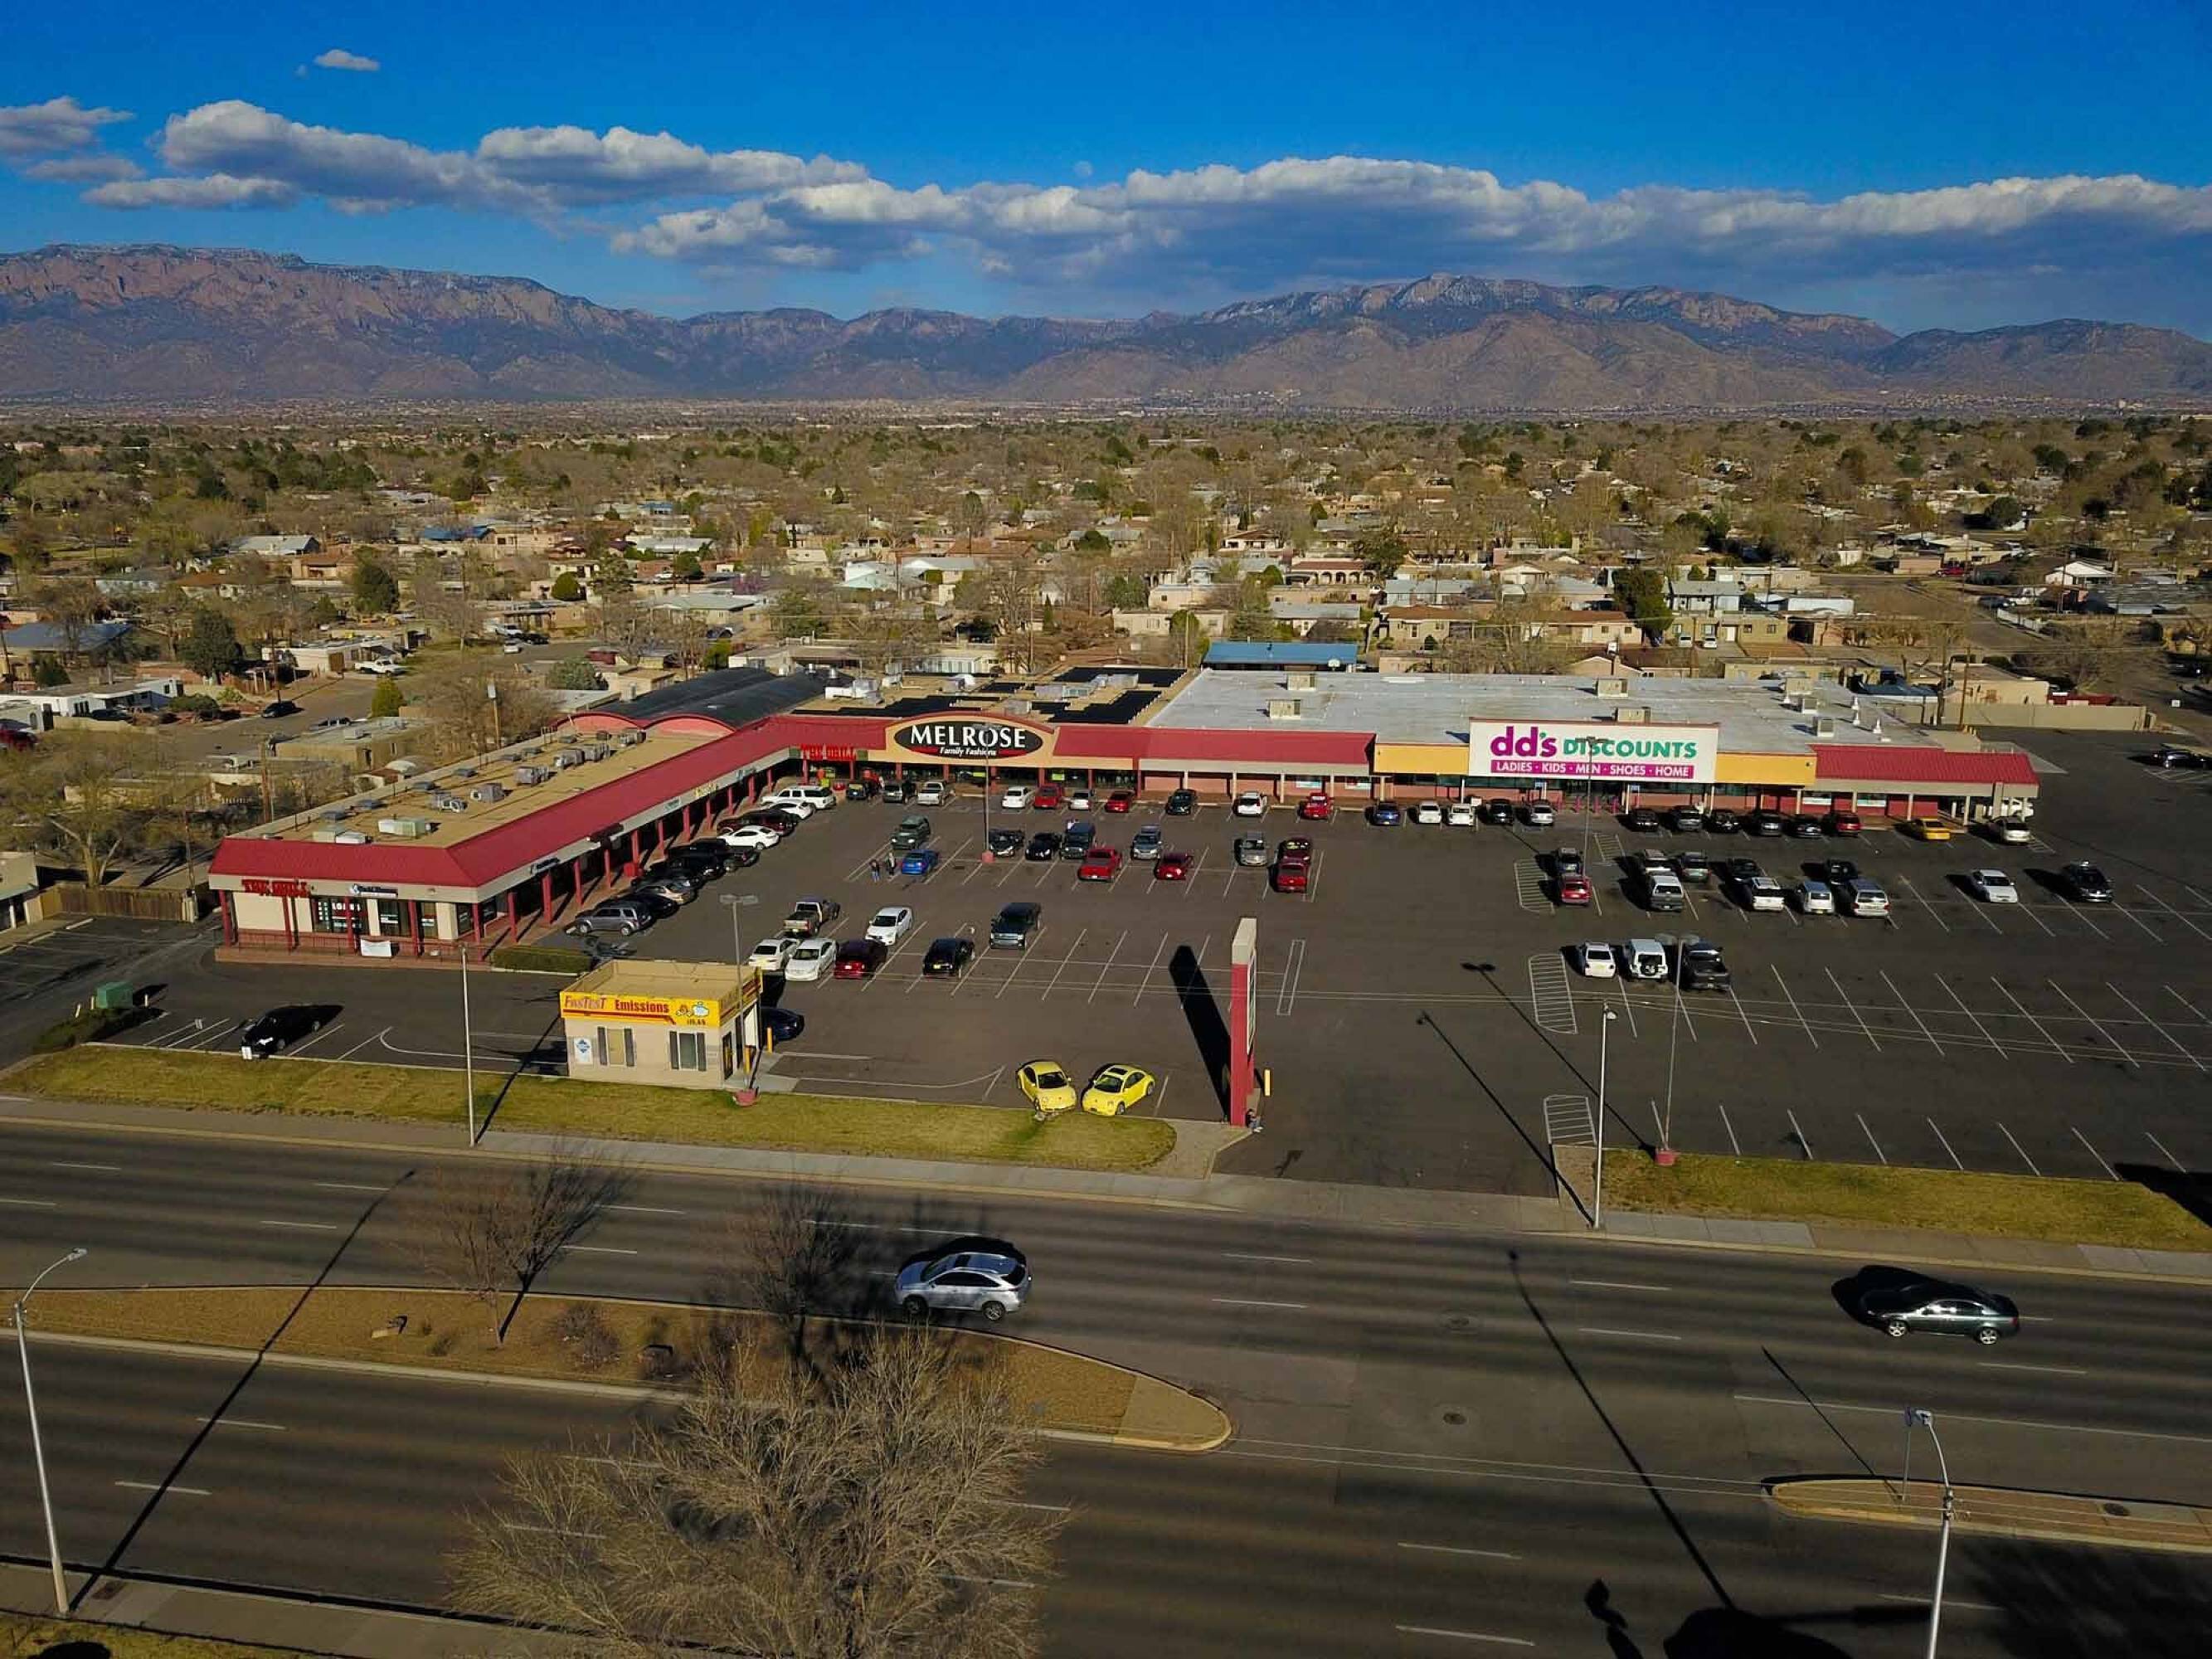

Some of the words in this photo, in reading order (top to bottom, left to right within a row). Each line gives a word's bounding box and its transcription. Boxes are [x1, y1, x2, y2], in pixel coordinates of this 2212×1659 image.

[911, 724, 1026, 747] MELROSE
[1490, 726, 1558, 757] dd's
[1563, 737, 1698, 758] DISCOUNTS
[940, 747, 964, 757] Family
[1496, 761, 1533, 771] LADIES
[1542, 763, 1567, 773] KIDS
[1575, 765, 1601, 774] MEN
[1610, 766, 1646, 776] SHOES
[1655, 766, 1689, 776] HOME
[615, 998, 669, 1014] Emissions
